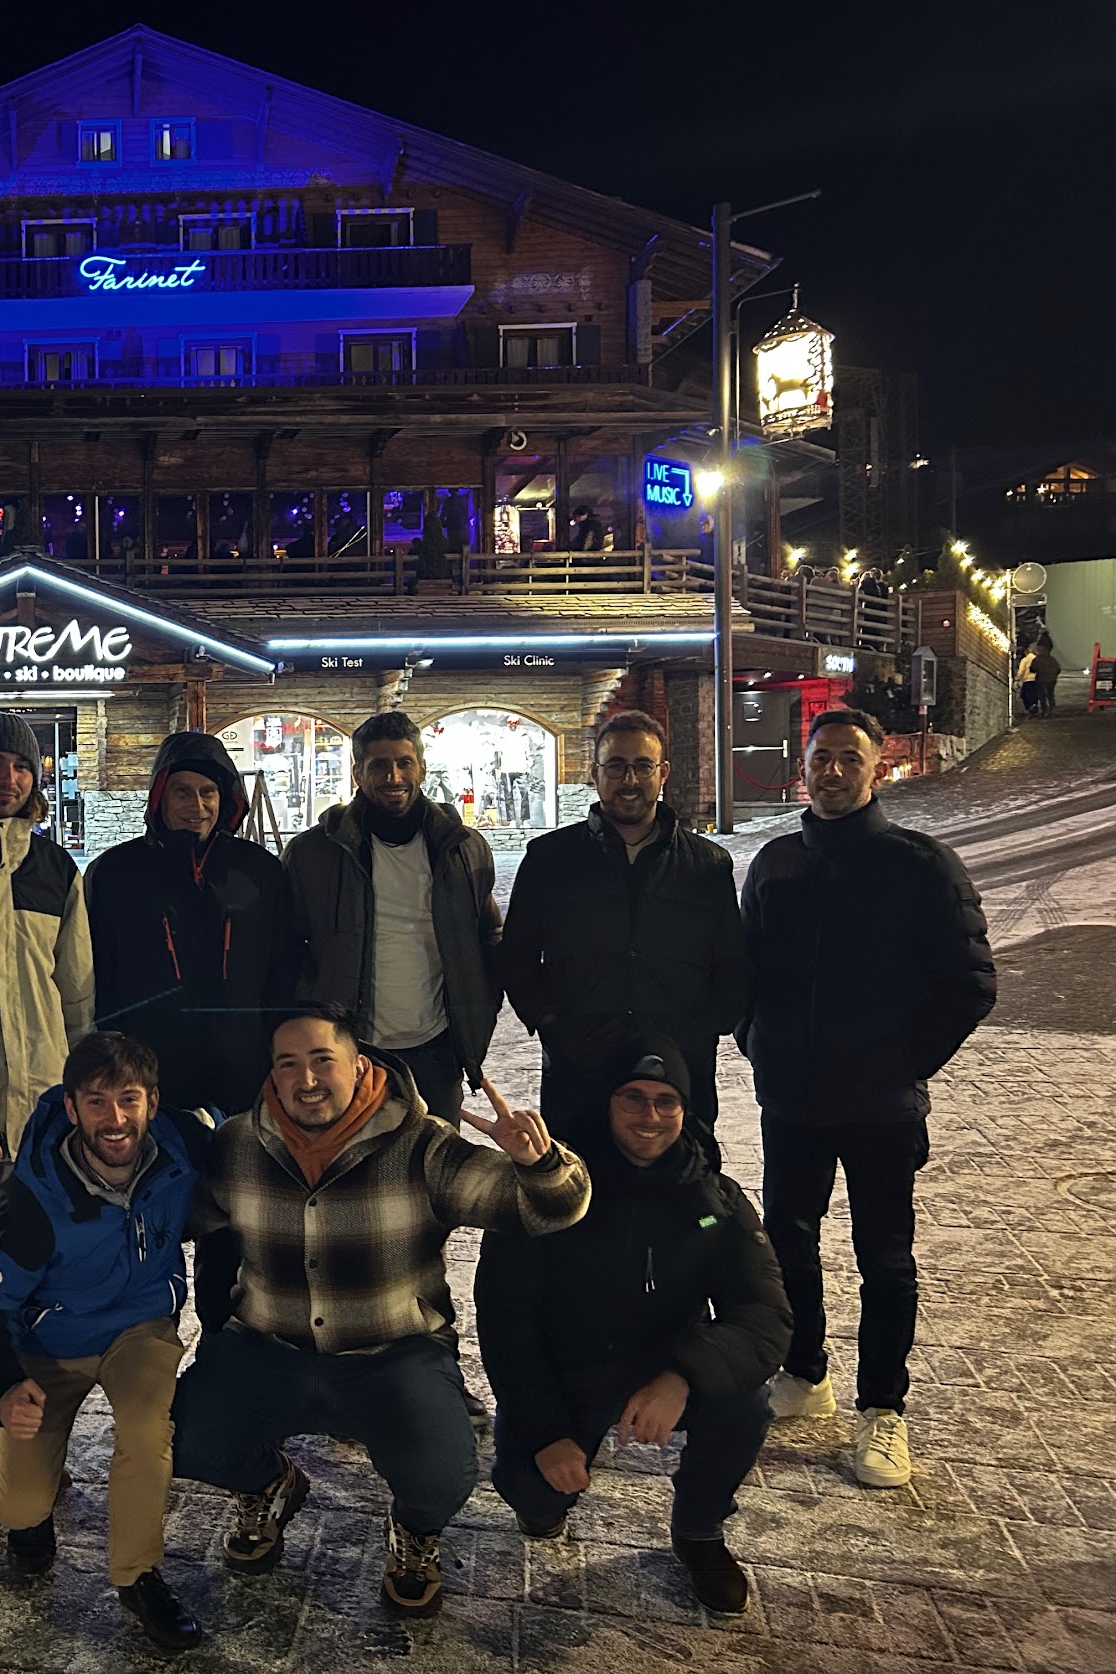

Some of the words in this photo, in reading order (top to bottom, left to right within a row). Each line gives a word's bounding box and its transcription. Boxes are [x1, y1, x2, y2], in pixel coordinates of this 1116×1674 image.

[80, 256, 205, 290] Farinet
[647, 462, 670, 483] LIVE
[647, 484, 682, 505] MUSIC
[321, 656, 338, 668] Ski
[341, 656, 363, 668] Test
[503, 655, 521, 666] Ski
[523, 655, 555, 666] Clinic
[15, 666, 38, 681] ski
[53, 665, 126, 683] boutique
